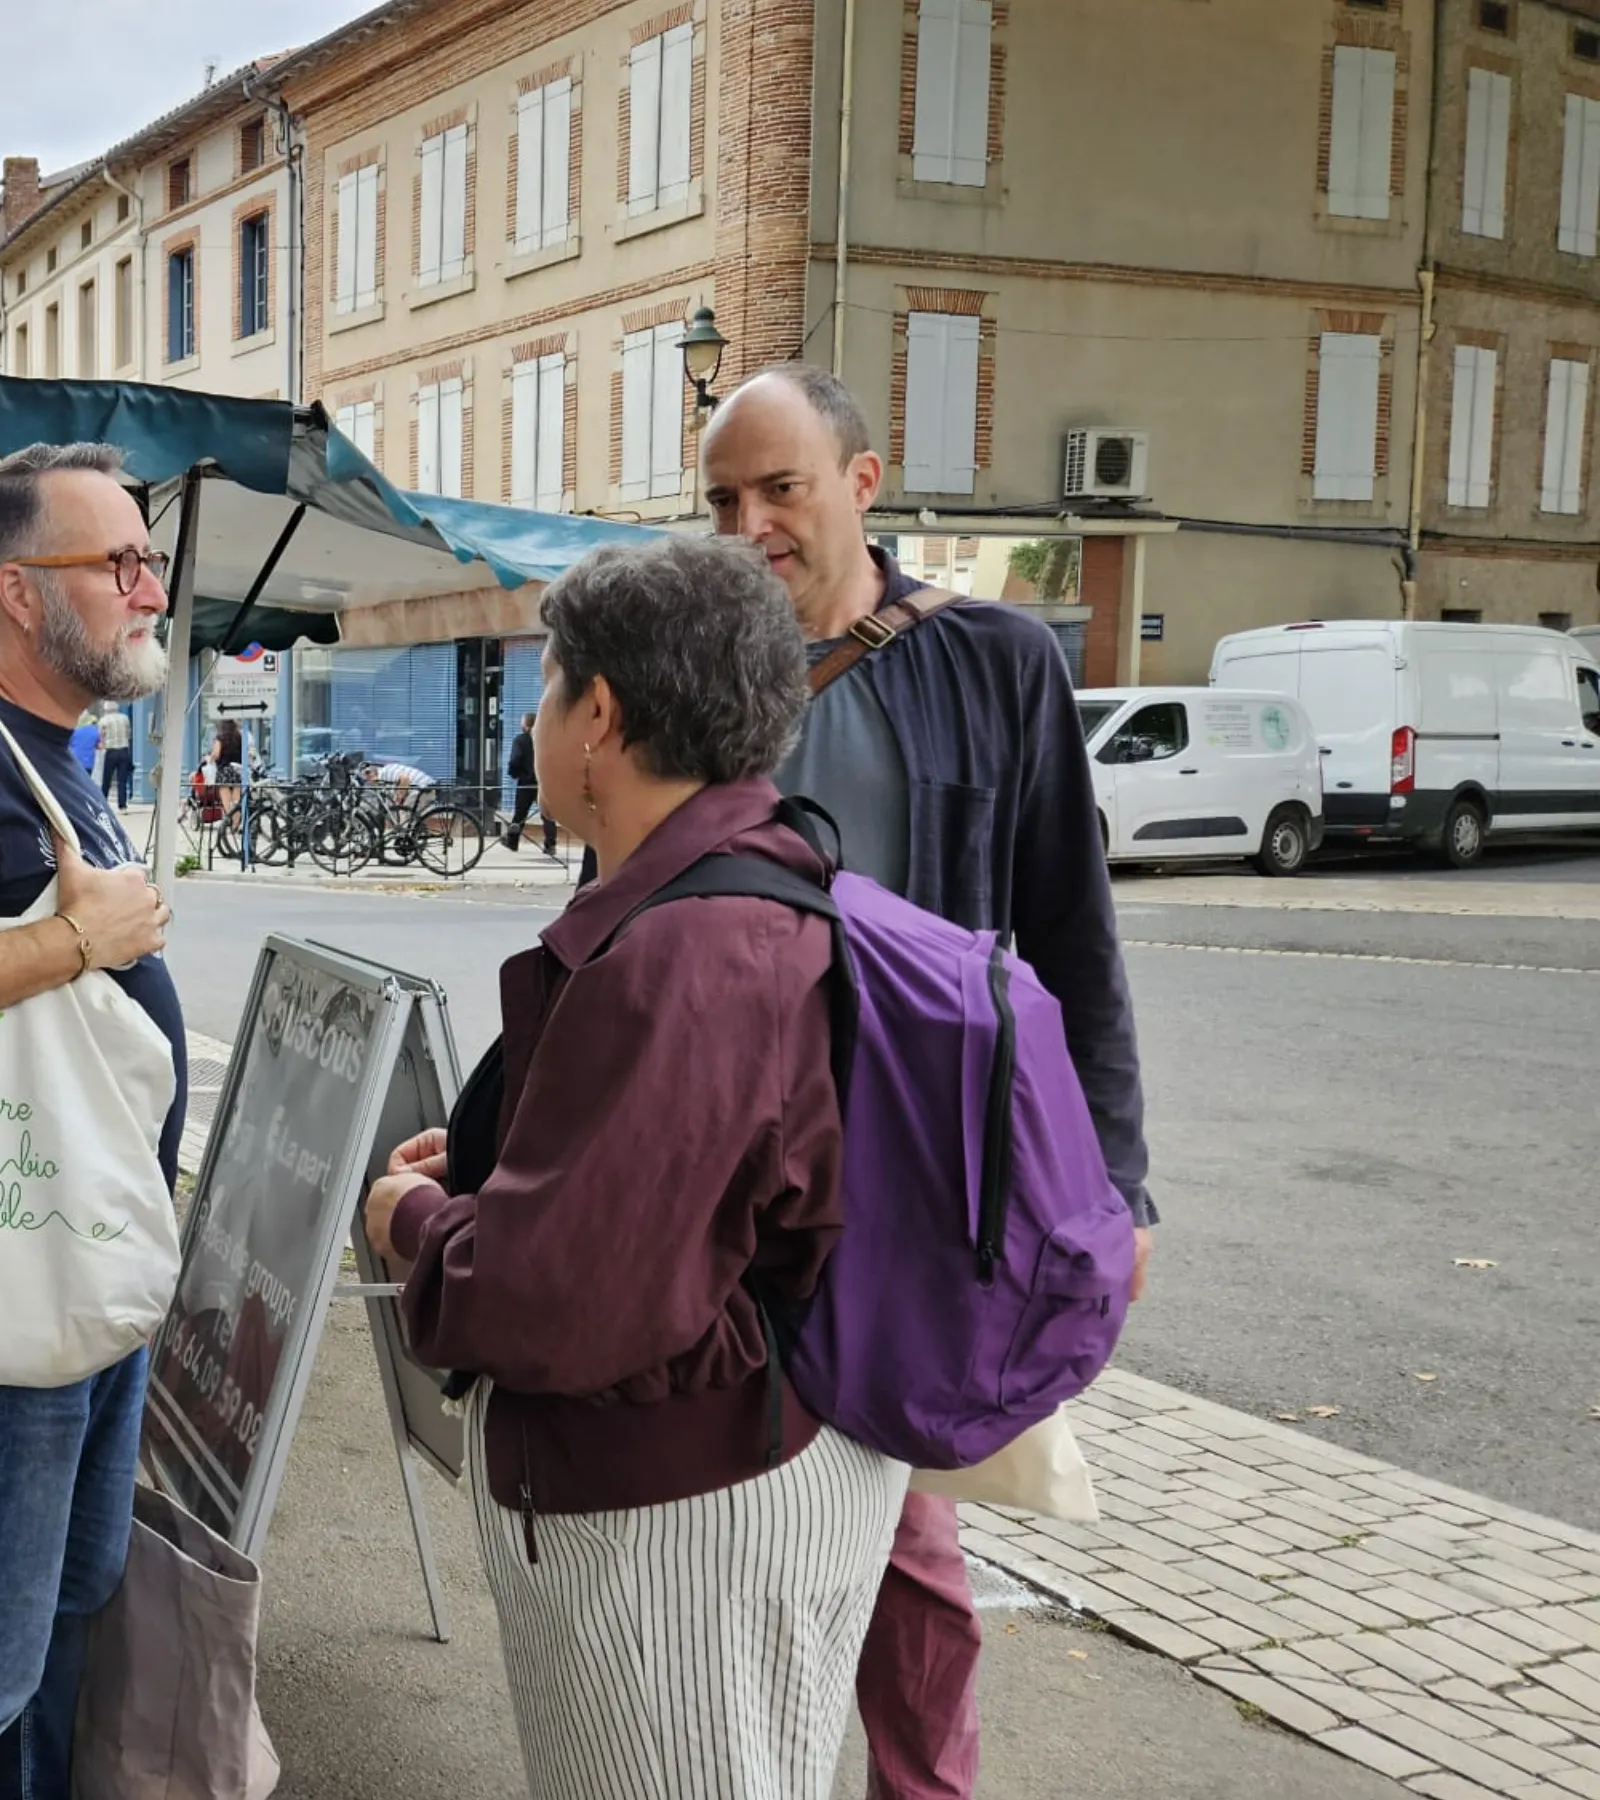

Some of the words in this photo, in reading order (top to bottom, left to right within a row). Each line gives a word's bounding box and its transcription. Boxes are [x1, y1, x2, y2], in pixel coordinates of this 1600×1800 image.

[262, 982, 366, 1084] Couscous
[19, 1129, 60, 1179] bio
[294, 1149, 333, 1194] part
